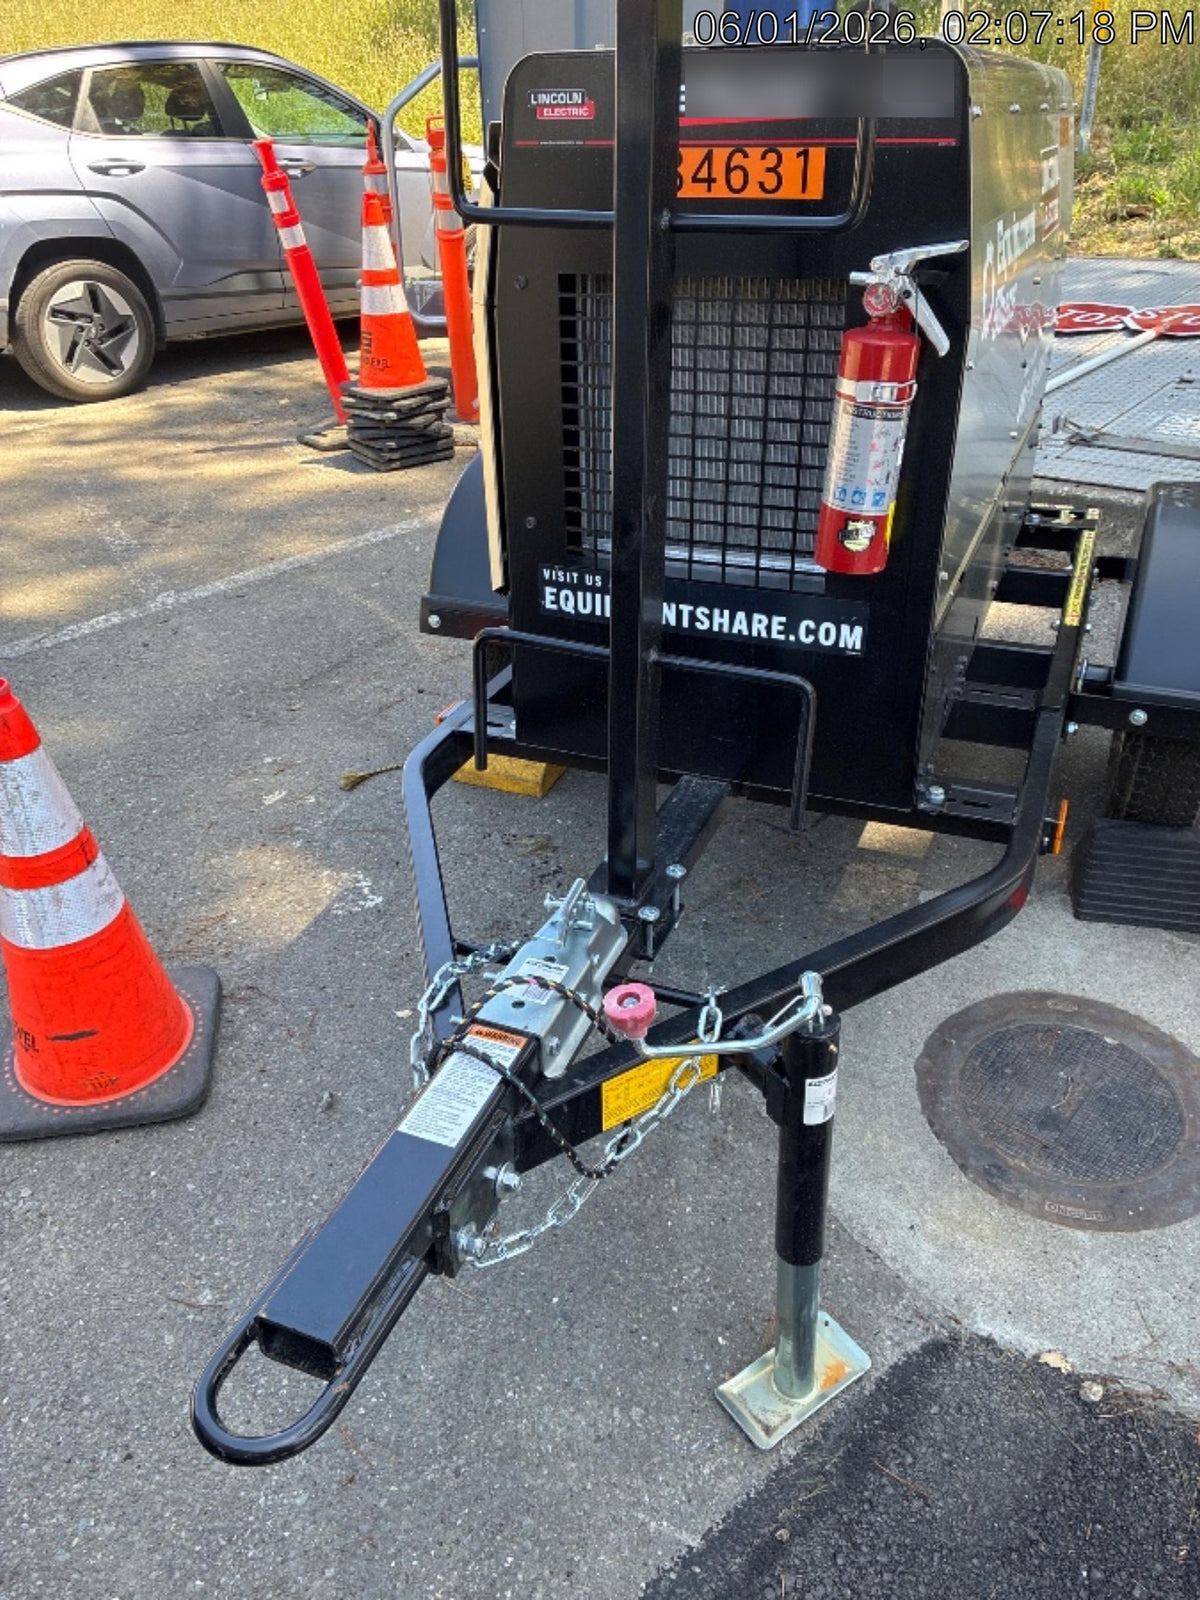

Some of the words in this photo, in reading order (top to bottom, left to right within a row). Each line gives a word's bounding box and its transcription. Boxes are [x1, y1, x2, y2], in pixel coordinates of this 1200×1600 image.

[530, 92, 583, 105] LINCOLN
[543, 107, 590, 117] ELECTRIC
[676, 146, 810, 195] 4631
[543, 568, 579, 585] VISIT
[585, 573, 602, 587] US
[543, 586, 864, 650] EQUINTSHARE.COM
